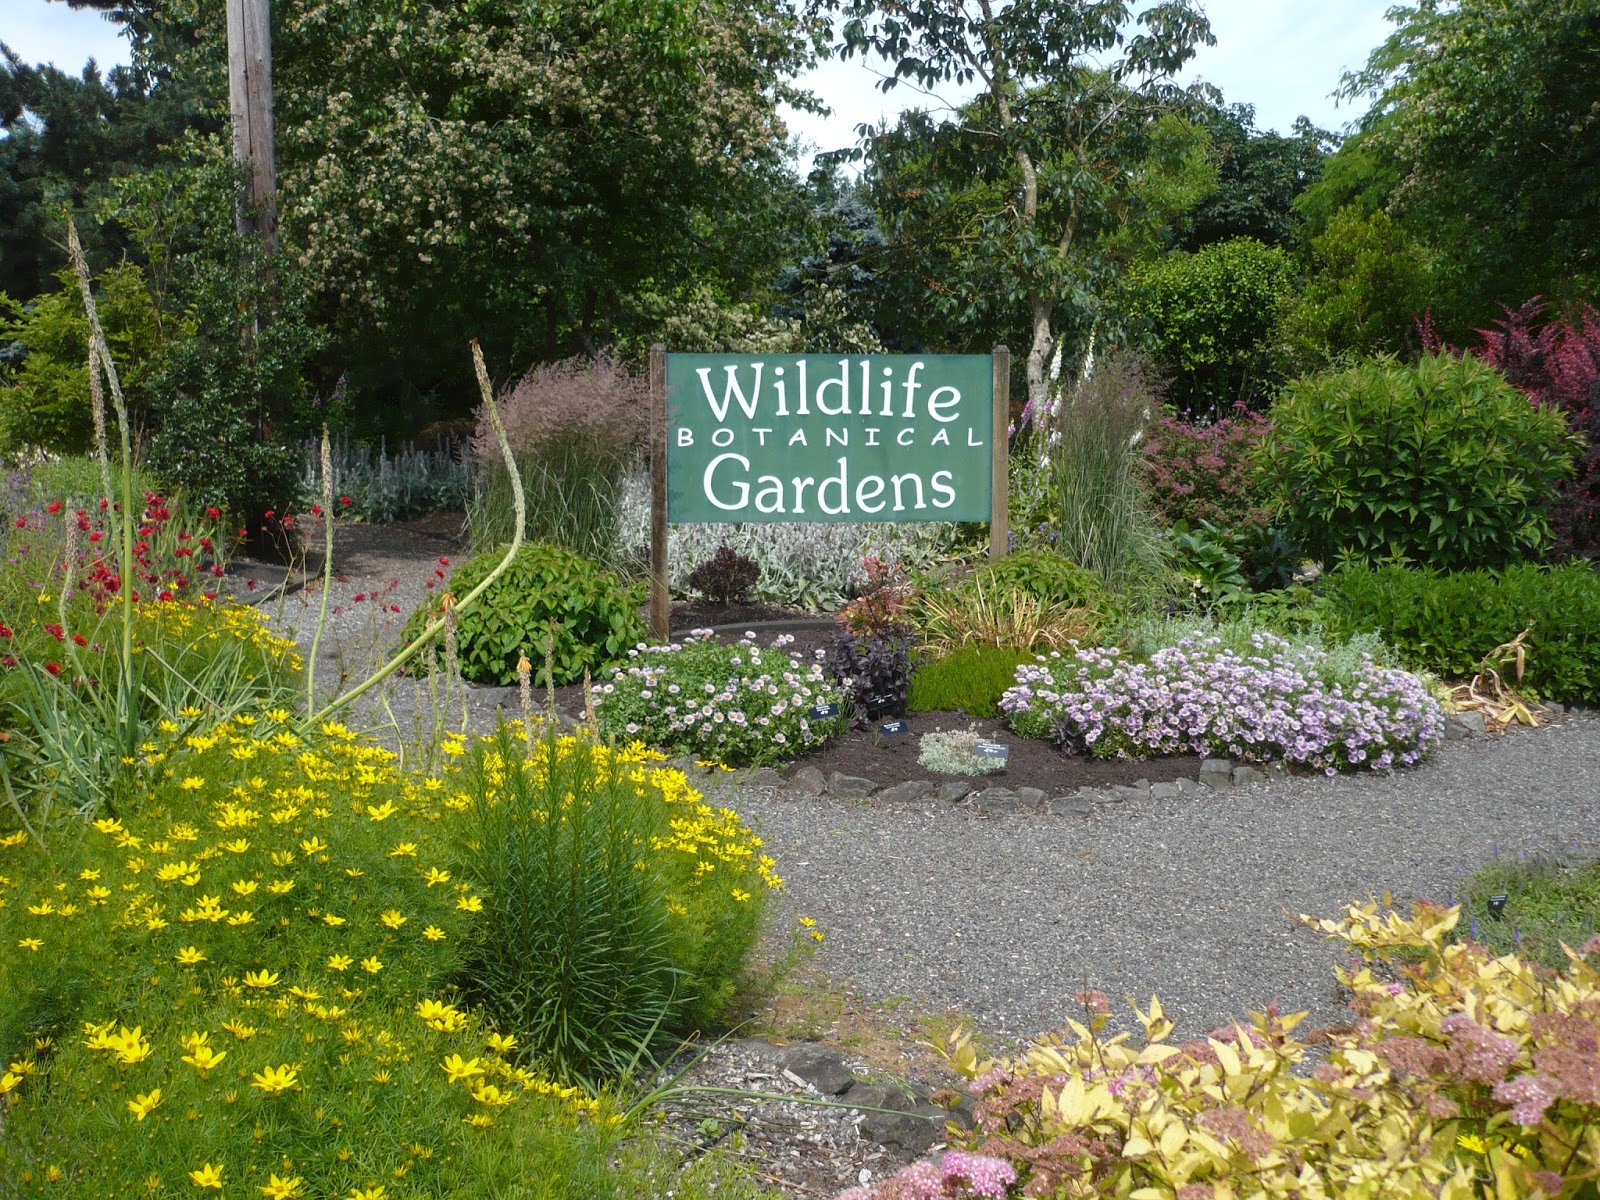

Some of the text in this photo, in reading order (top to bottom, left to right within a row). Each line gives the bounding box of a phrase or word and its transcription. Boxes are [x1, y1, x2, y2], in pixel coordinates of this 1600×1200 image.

[695, 358, 962, 423] Wildlife
[677, 427, 984, 448] BOTANICAL
[702, 452, 957, 515] Gardens
